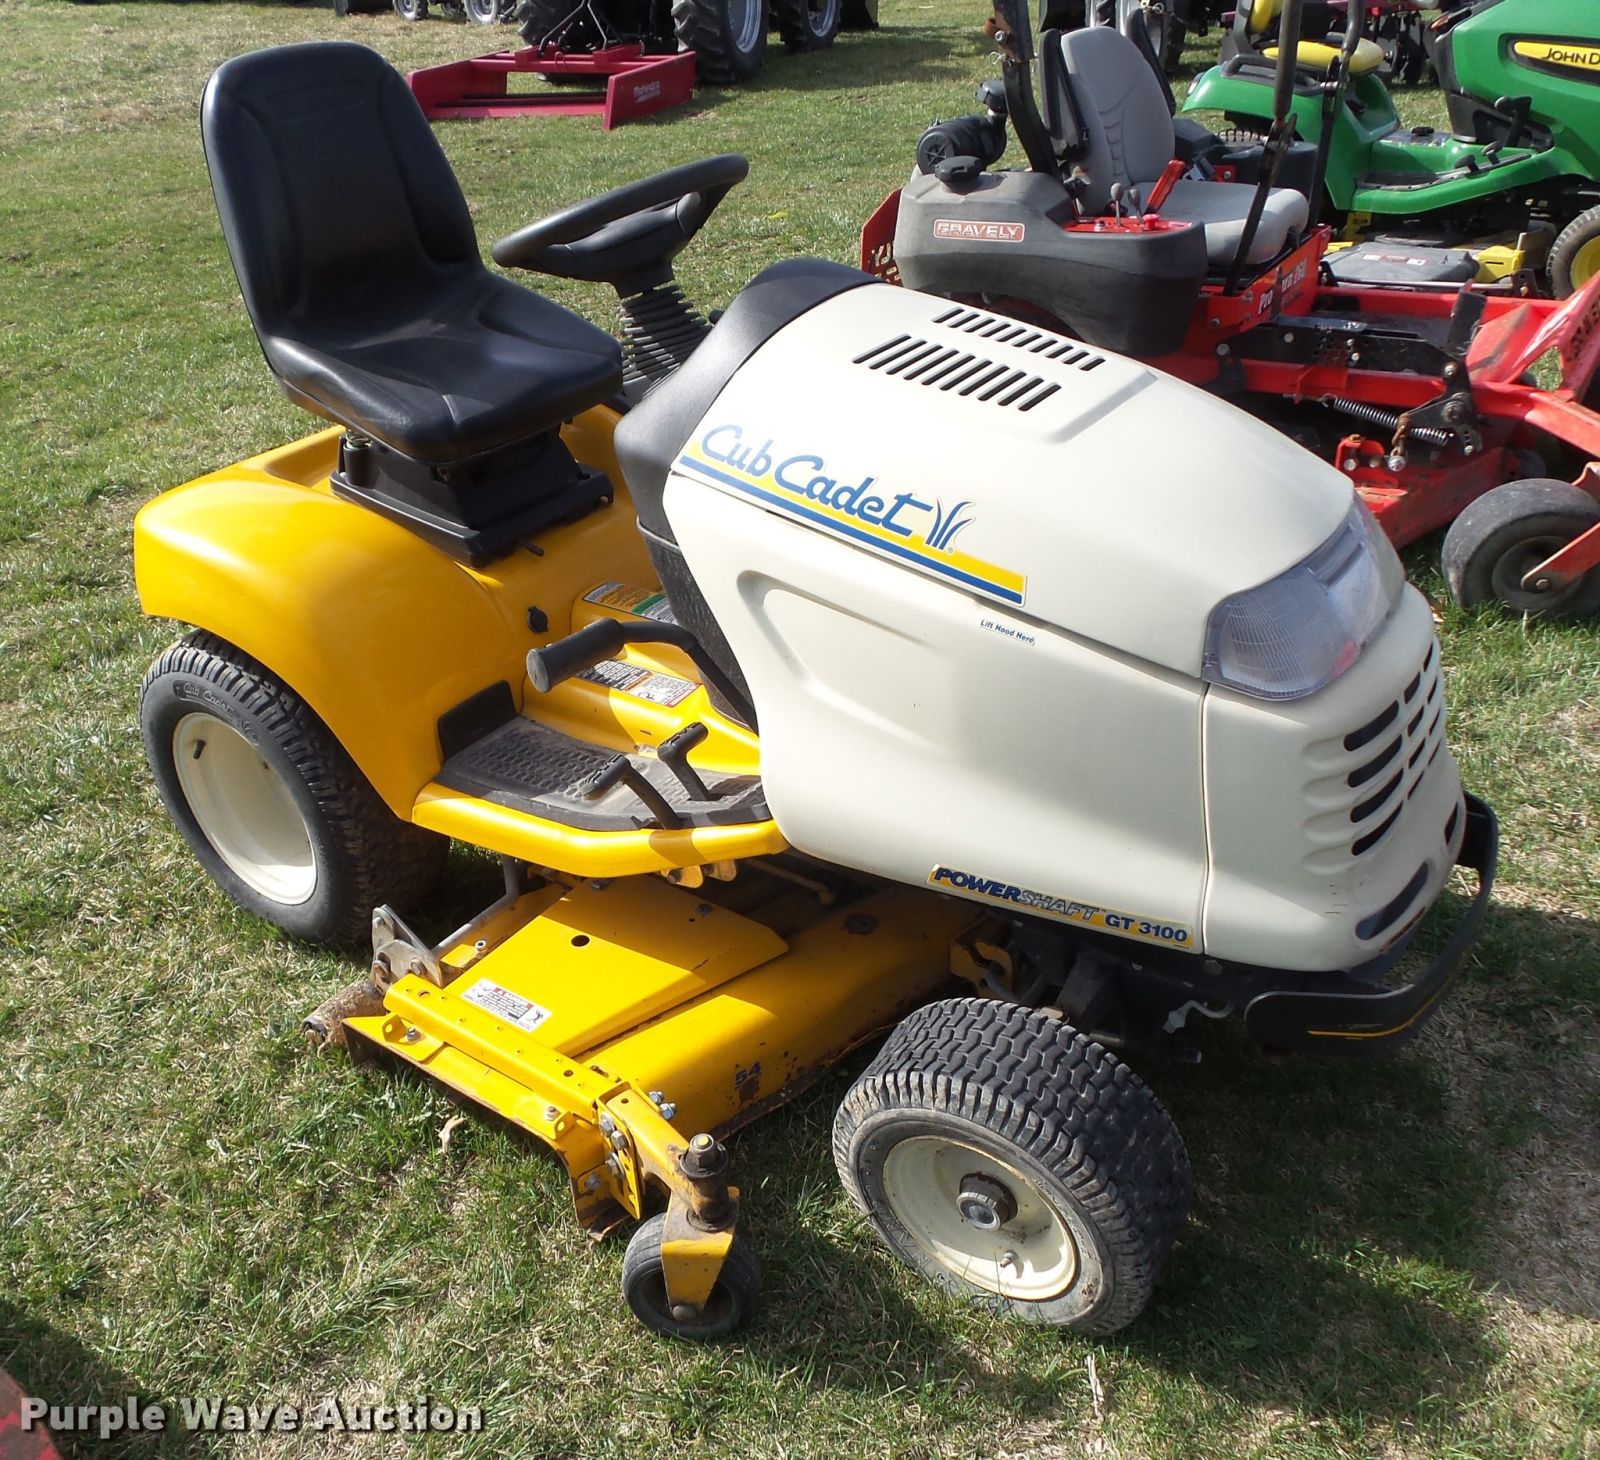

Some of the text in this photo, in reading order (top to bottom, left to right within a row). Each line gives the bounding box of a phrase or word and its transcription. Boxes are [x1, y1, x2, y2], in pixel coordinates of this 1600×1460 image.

[1541, 47, 1587, 65] JOHN
[936, 222, 1021, 240] GRAVELY
[701, 424, 934, 537] Cub Cadet
[980, 618, 1035, 644] Lift Hood Here
[1104, 913, 1135, 931] GT
[1137, 921, 1188, 943] 3100
